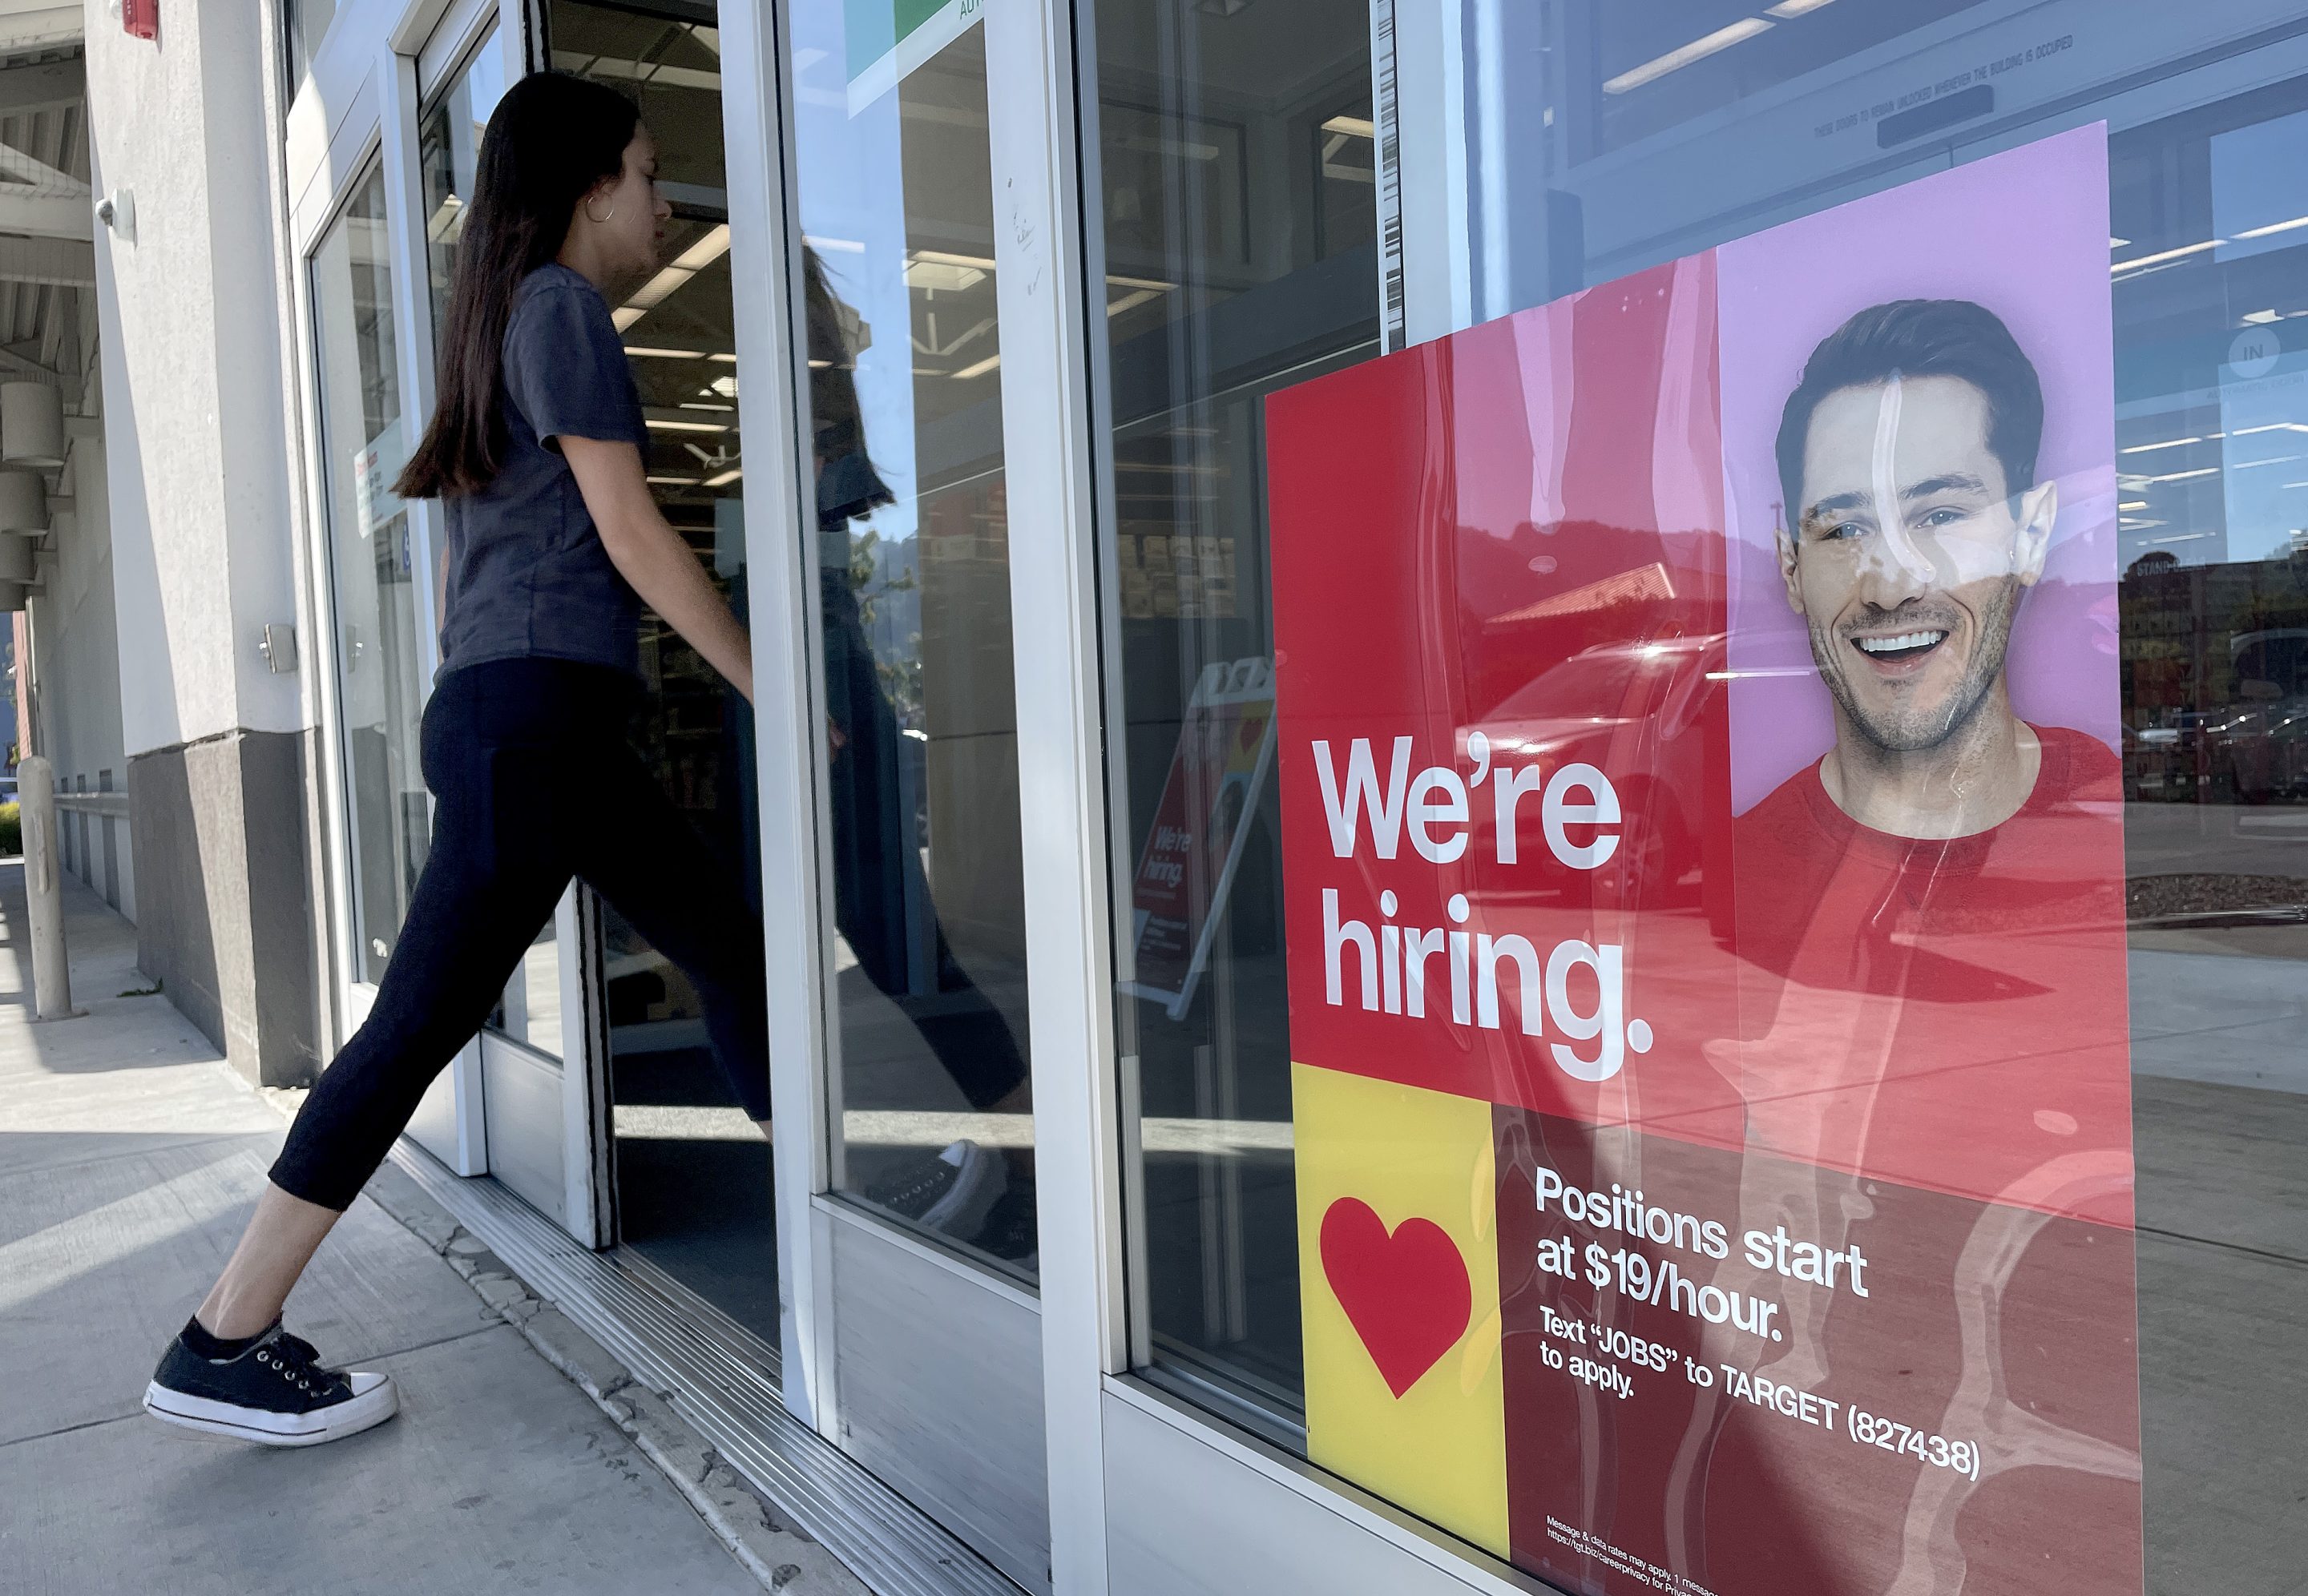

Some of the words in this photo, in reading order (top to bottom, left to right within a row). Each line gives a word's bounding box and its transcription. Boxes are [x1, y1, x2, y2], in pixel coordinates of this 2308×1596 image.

[1974, 65, 1988, 80] THE
[1991, 53, 2024, 76] BUILDING
[2026, 49, 2033, 62] IS
[2036, 34, 2074, 59] OCCUPIED
[2244, 344, 2264, 361] IN
[1312, 732, 1621, 869] We’re
[1322, 888, 1654, 1082] hiring.
[1535, 1167, 1729, 1259] Positions
[1744, 1226, 1869, 1298] start
[1537, 1235, 1575, 1279] at
[1584, 1241, 1782, 1342] $19/hour.
[1539, 1340, 1563, 1369] to
[1568, 1356, 1635, 1399] apply.
[1539, 1306, 1586, 1344] Text
[1685, 1356, 1713, 1387] to
[1721, 1364, 1839, 1430] TARGET
[1847, 1405, 1981, 1481] (827438)
[1547, 1514, 1580, 1538] Message
[1582, 1531, 1589, 1542] &
[1591, 1535, 1607, 1550] data
[1608, 1545, 1628, 1561] rates
[1628, 1555, 1646, 1570] may
[1648, 1564, 1672, 1582] apply.
[1674, 1574, 1679, 1584] 1
[1547, 1527, 1650, 1586] https://tgt.biz/careerprivacy
[1652, 1577, 1663, 1590] for
